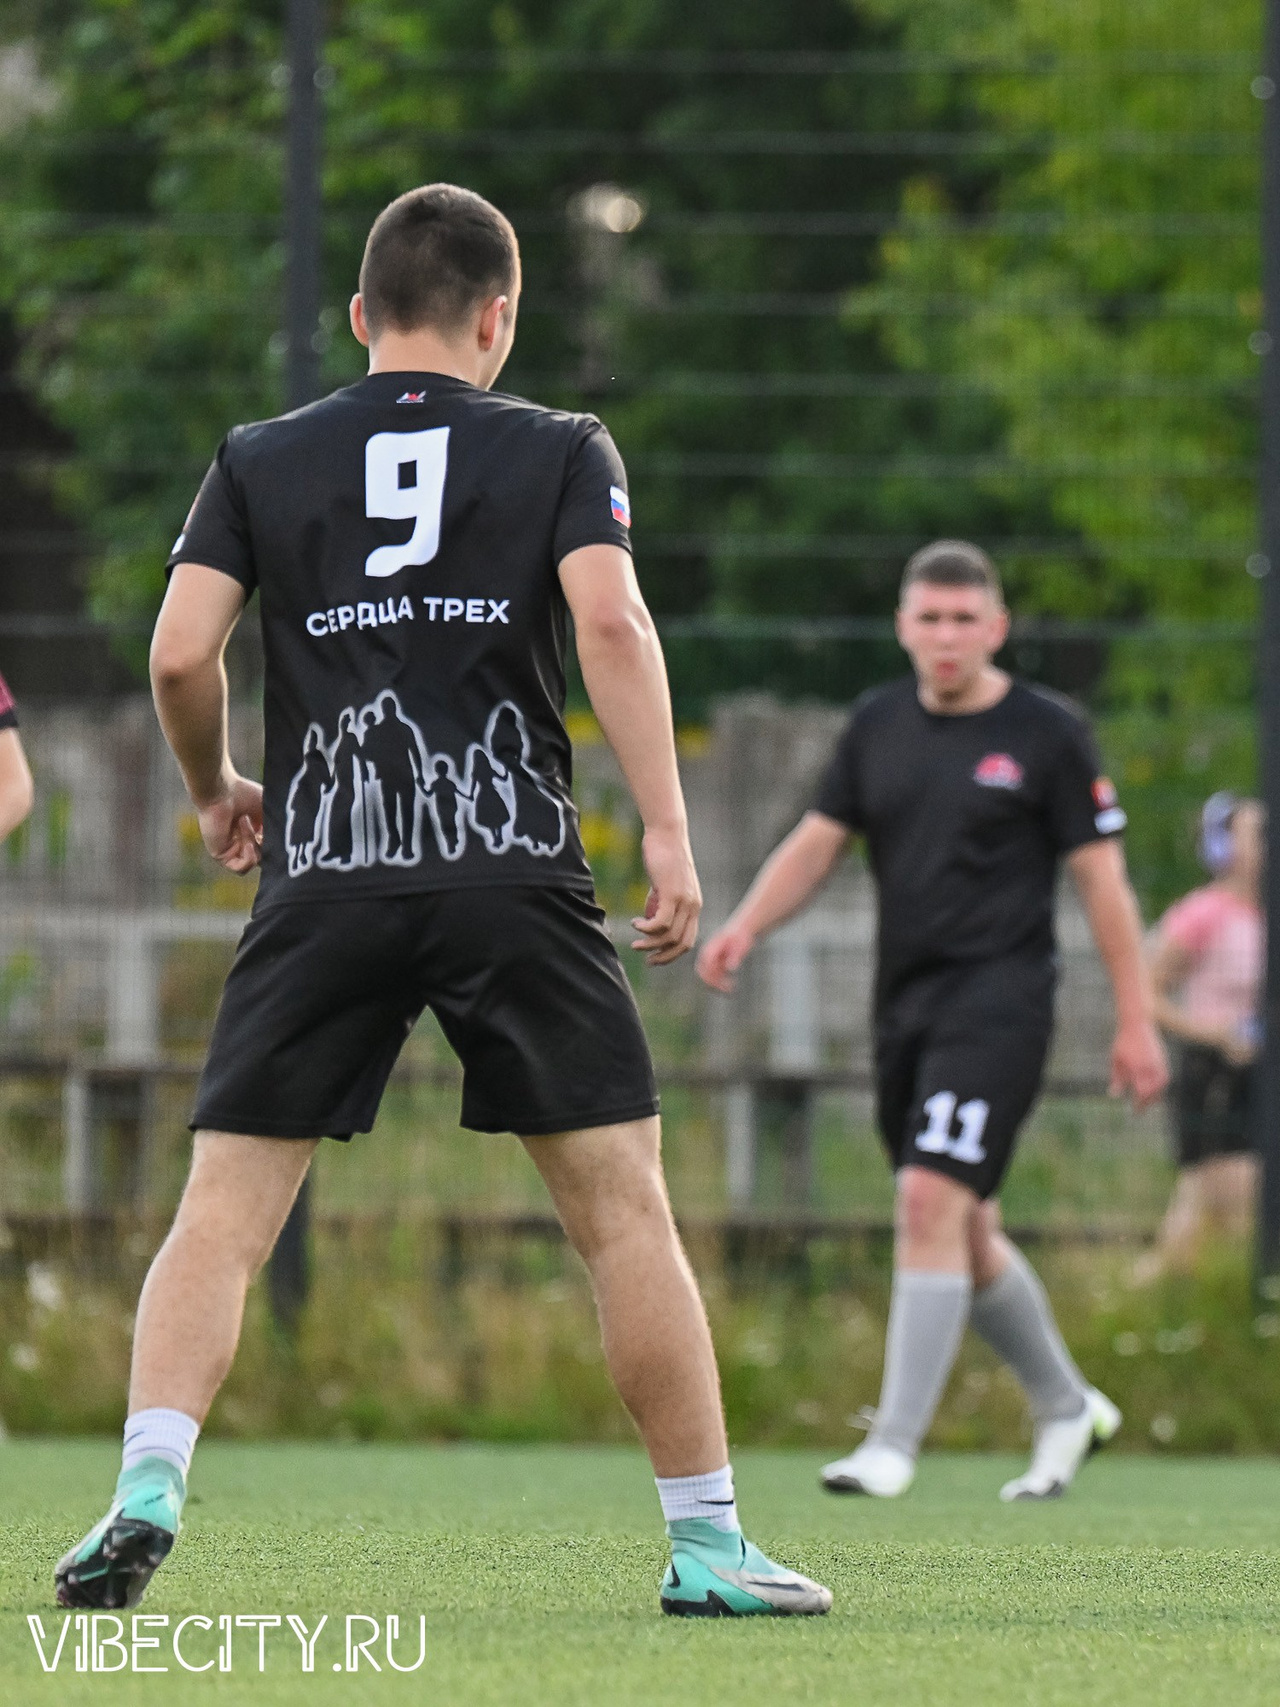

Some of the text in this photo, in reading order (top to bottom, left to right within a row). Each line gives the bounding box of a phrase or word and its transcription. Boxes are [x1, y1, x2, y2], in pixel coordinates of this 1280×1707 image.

[365, 426, 450, 577] 9
[306, 596, 511, 638] СЕРДЦА ТРЕХ
[915, 1090, 991, 1165] 11
